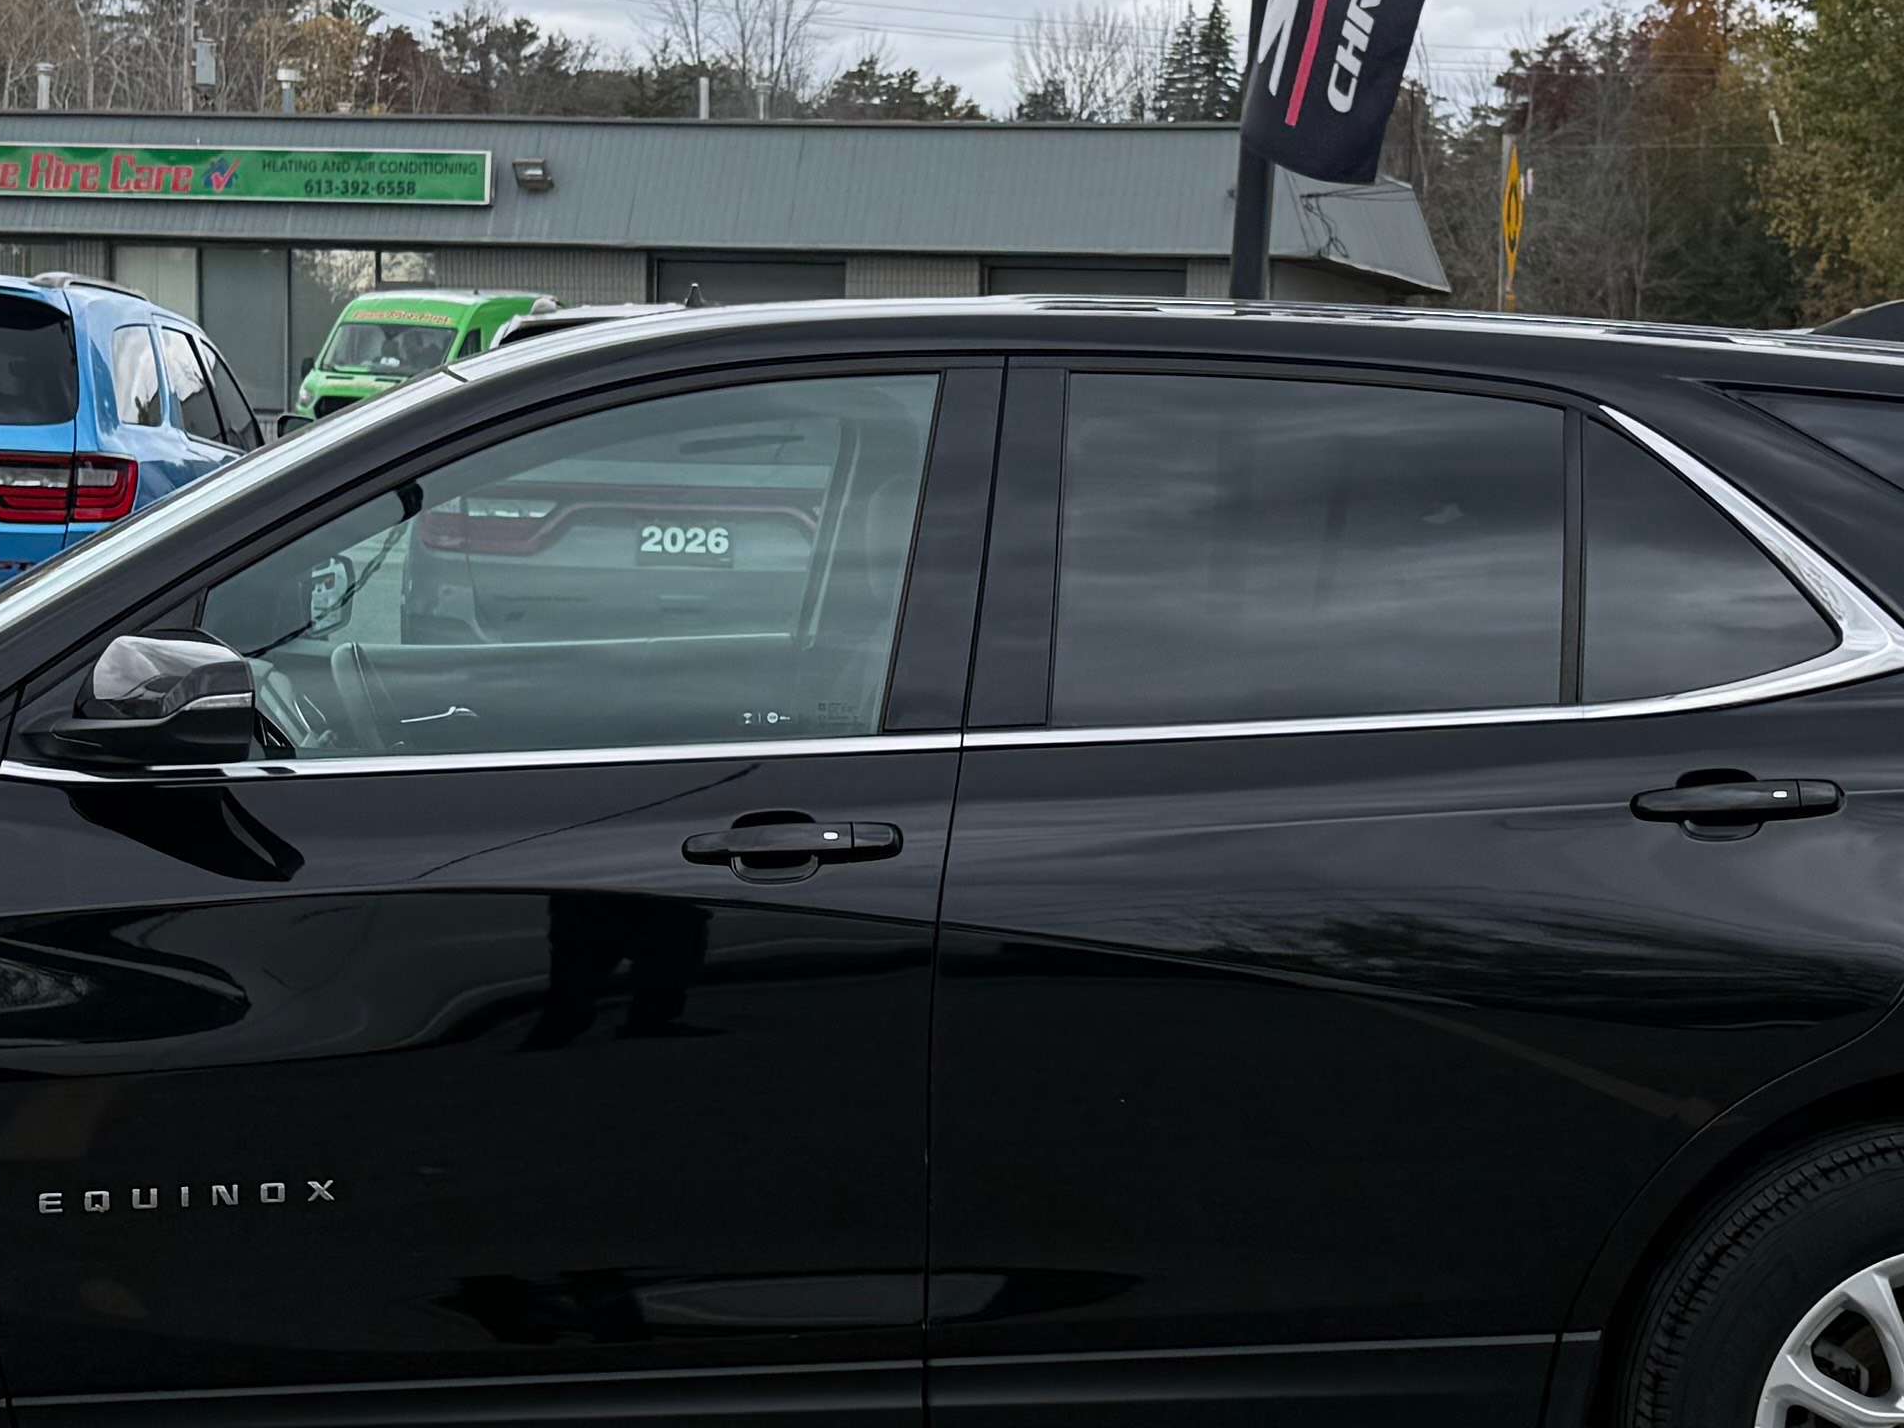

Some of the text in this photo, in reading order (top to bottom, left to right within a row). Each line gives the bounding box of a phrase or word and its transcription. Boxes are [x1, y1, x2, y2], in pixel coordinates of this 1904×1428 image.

[27, 151, 101, 192] Aire
[108, 153, 194, 194] Care
[261, 159, 479, 176] HEATING AND AIR CONDITIONING
[303, 178, 417, 196] 613-392-6558
[640, 525, 729, 554] 2026
[38, 1179, 336, 1214] EQUINOX
